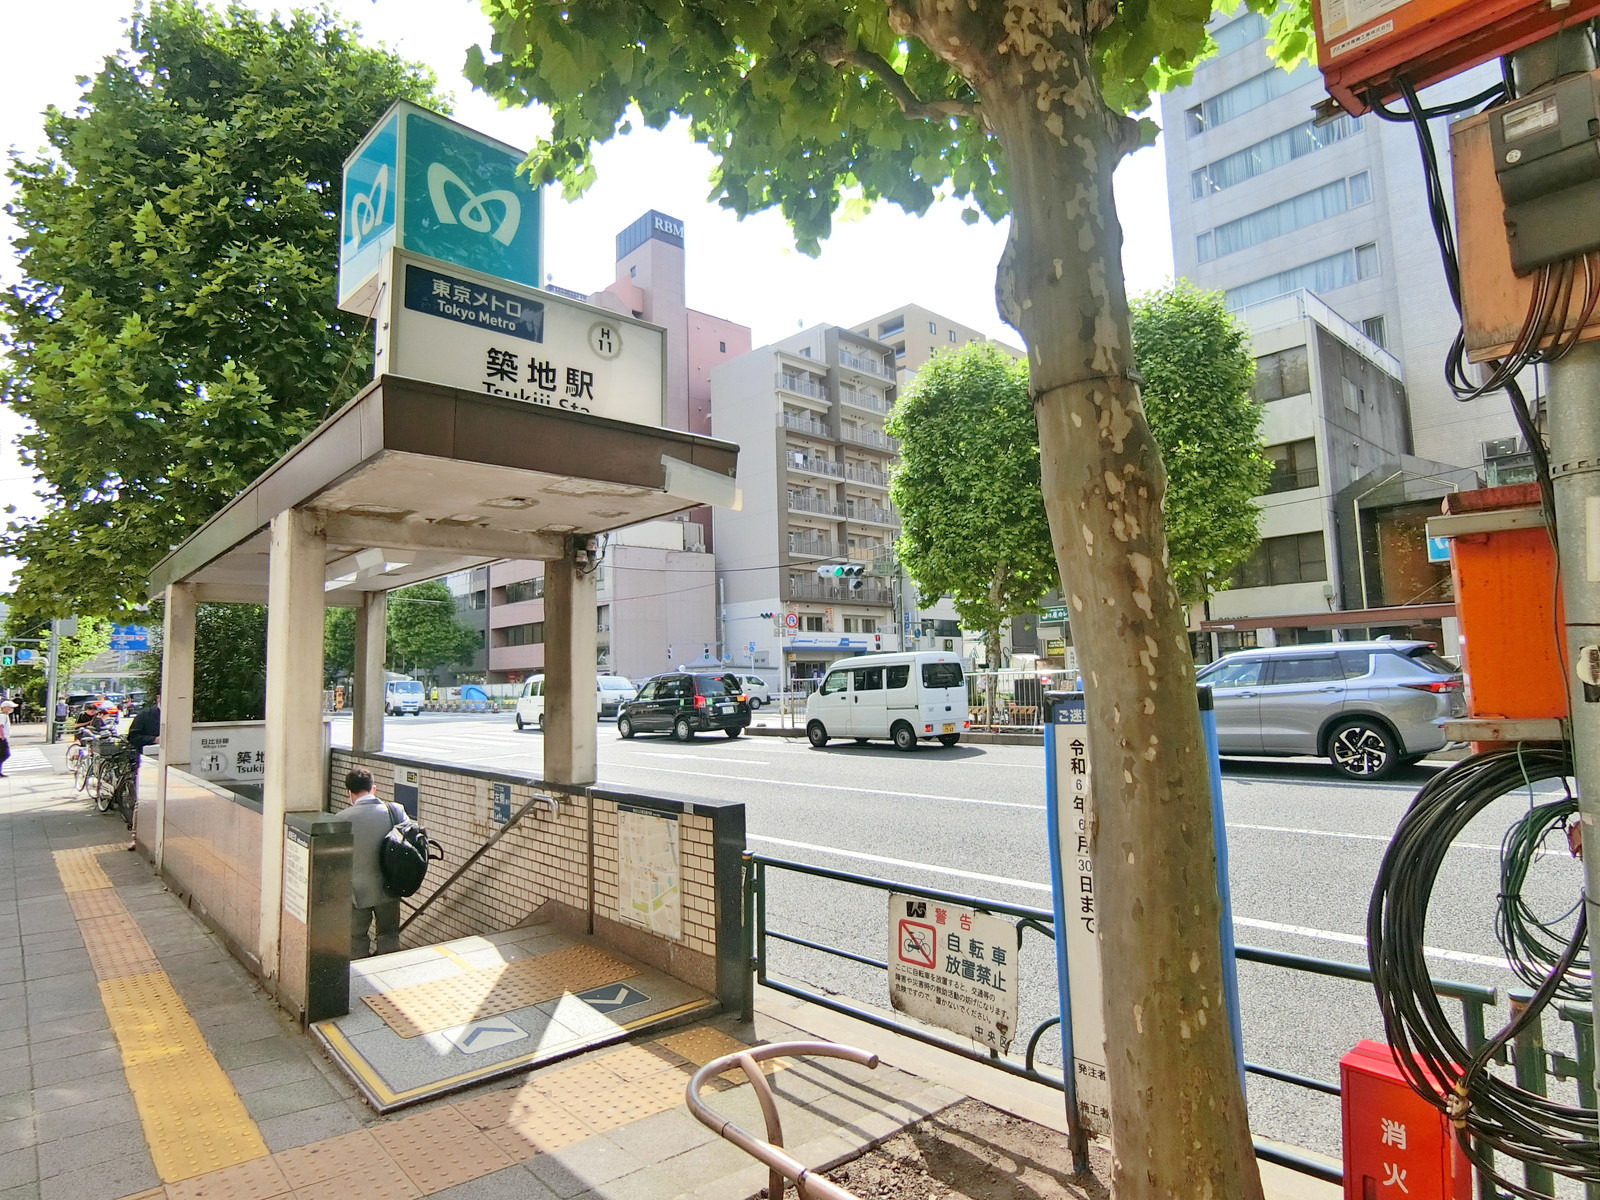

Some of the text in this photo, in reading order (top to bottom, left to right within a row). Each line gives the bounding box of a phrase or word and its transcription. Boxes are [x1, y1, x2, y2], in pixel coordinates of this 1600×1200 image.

[654, 216, 684, 239] RBM
[431, 279, 522, 318] 東京メトロ
[437, 299, 516, 331] Tokyo Metro
[601, 327, 610, 340] H
[598, 339, 612, 353] 11
[486, 347, 594, 401] 築地駅
[1058, 708, 1086, 723] ご迷
[209, 763, 219, 771] 11
[935, 907, 972, 931] 警告
[947, 932, 1007, 967] 自転車
[945, 954, 1007, 993] 放置禁止
[974, 1025, 1008, 1050] 中央区
[1078, 1062, 1106, 1081] 発注者
[1380, 1117, 1409, 1194] 消火
